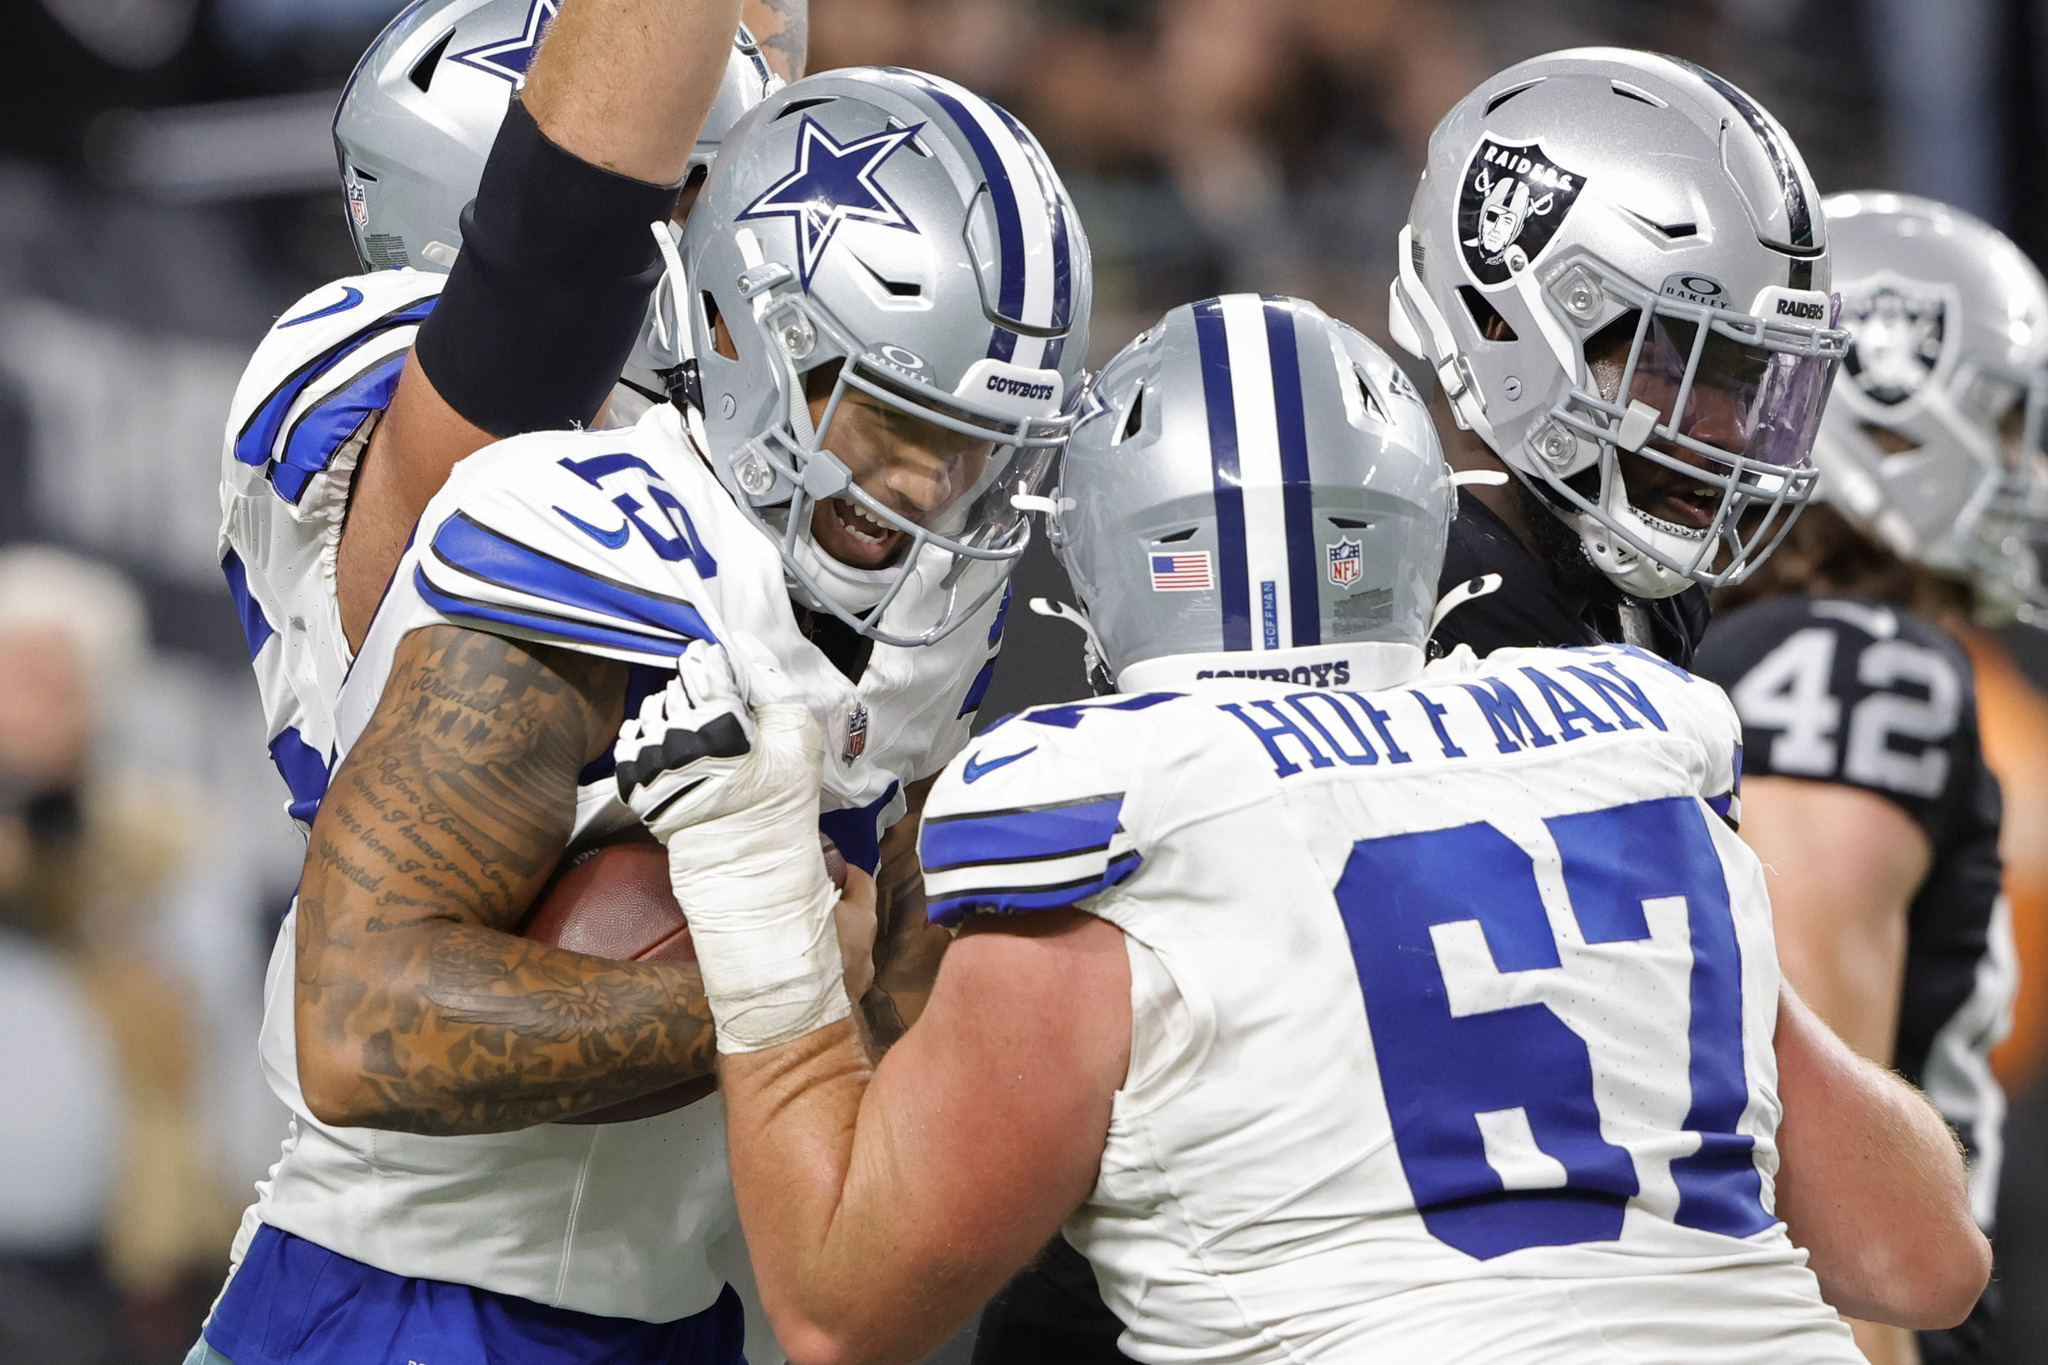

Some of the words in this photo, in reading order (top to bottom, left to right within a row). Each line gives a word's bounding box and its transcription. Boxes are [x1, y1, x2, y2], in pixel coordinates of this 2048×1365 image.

[1484, 145, 1573, 192] RAIDERS
[1665, 286, 1728, 309] OAKLEY
[1776, 299, 1825, 321] RAIDERS
[868, 352, 930, 384] OAKLEY
[986, 375, 1054, 401] COWBOYS
[1332, 561, 1360, 580] NFL
[1264, 582, 1277, 647] HOFFMAN
[1730, 625, 1961, 799] 42
[1333, 795, 1782, 1262] 67
